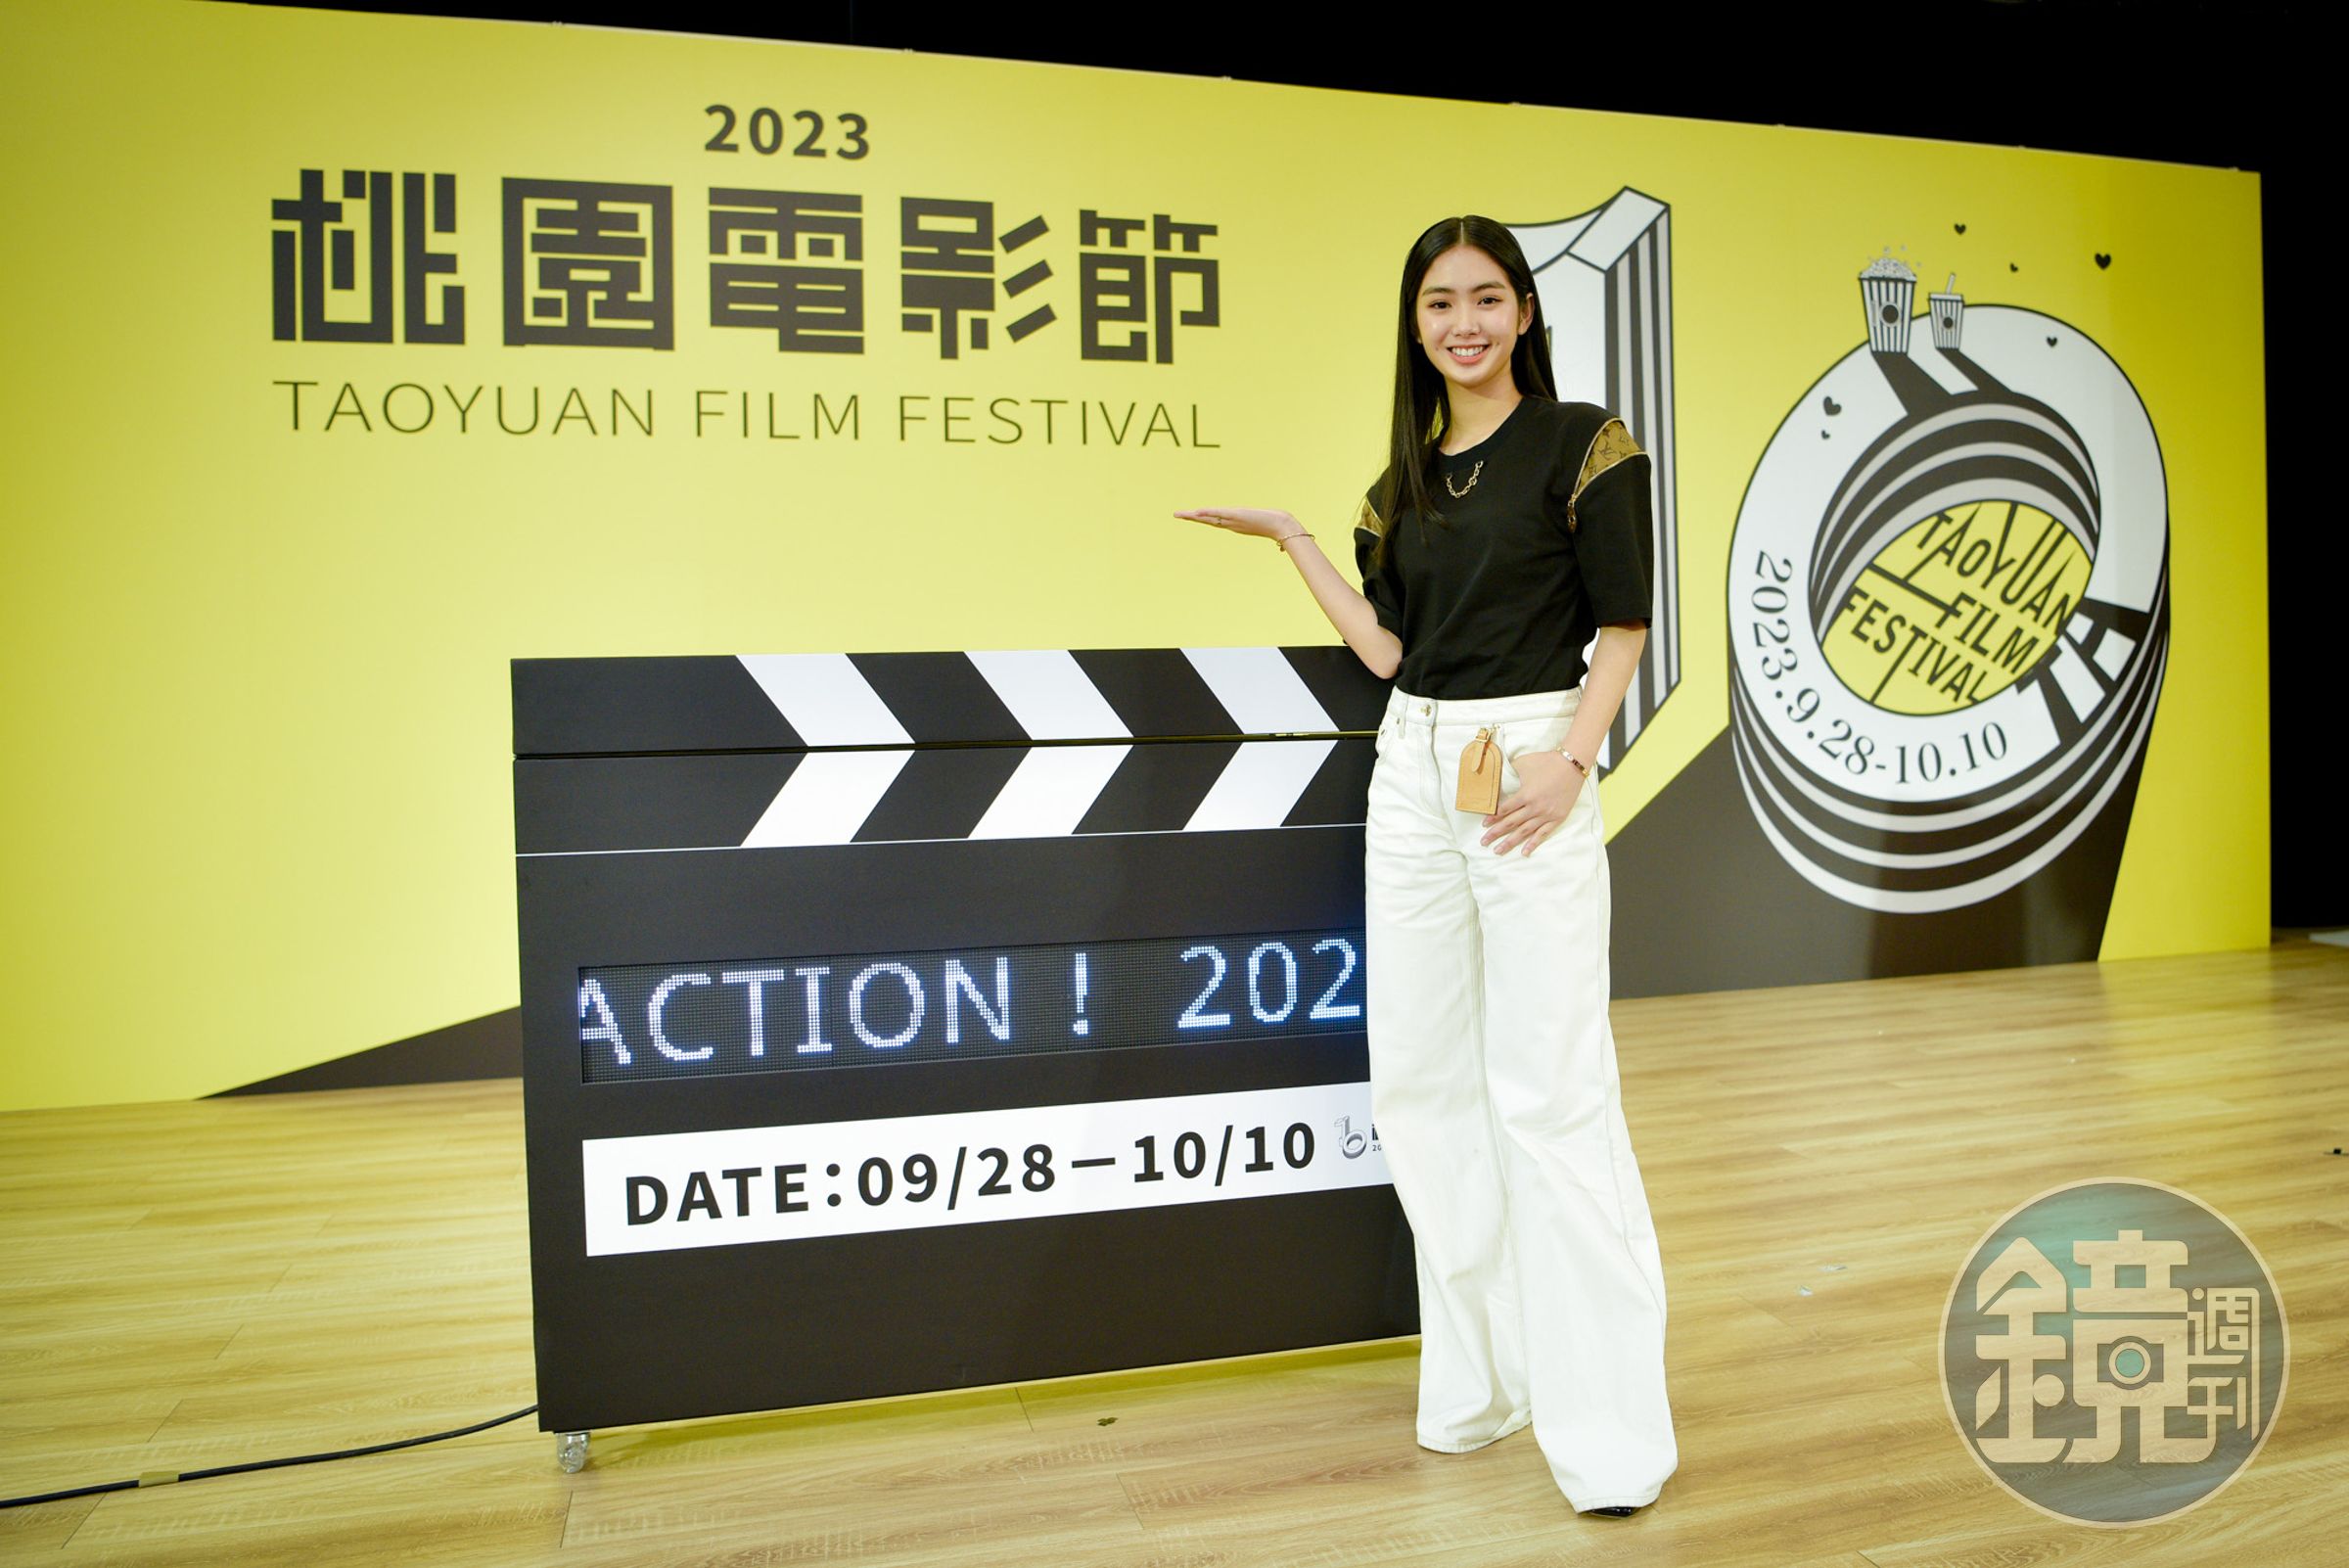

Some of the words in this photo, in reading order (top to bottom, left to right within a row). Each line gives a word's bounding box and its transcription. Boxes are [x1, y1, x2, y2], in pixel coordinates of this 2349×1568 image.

[706, 105, 871, 161] 2023
[272, 168, 1221, 366] 桃園電影節
[273, 380, 654, 438] TAOYUAN
[696, 390, 860, 442] FILM
[899, 395, 1221, 450] FESTIVAL
[1902, 501, 2074, 636] TAOYUAN
[1842, 584, 1981, 704] FESTIVAL
[580, 957, 1010, 1065] ACTION
